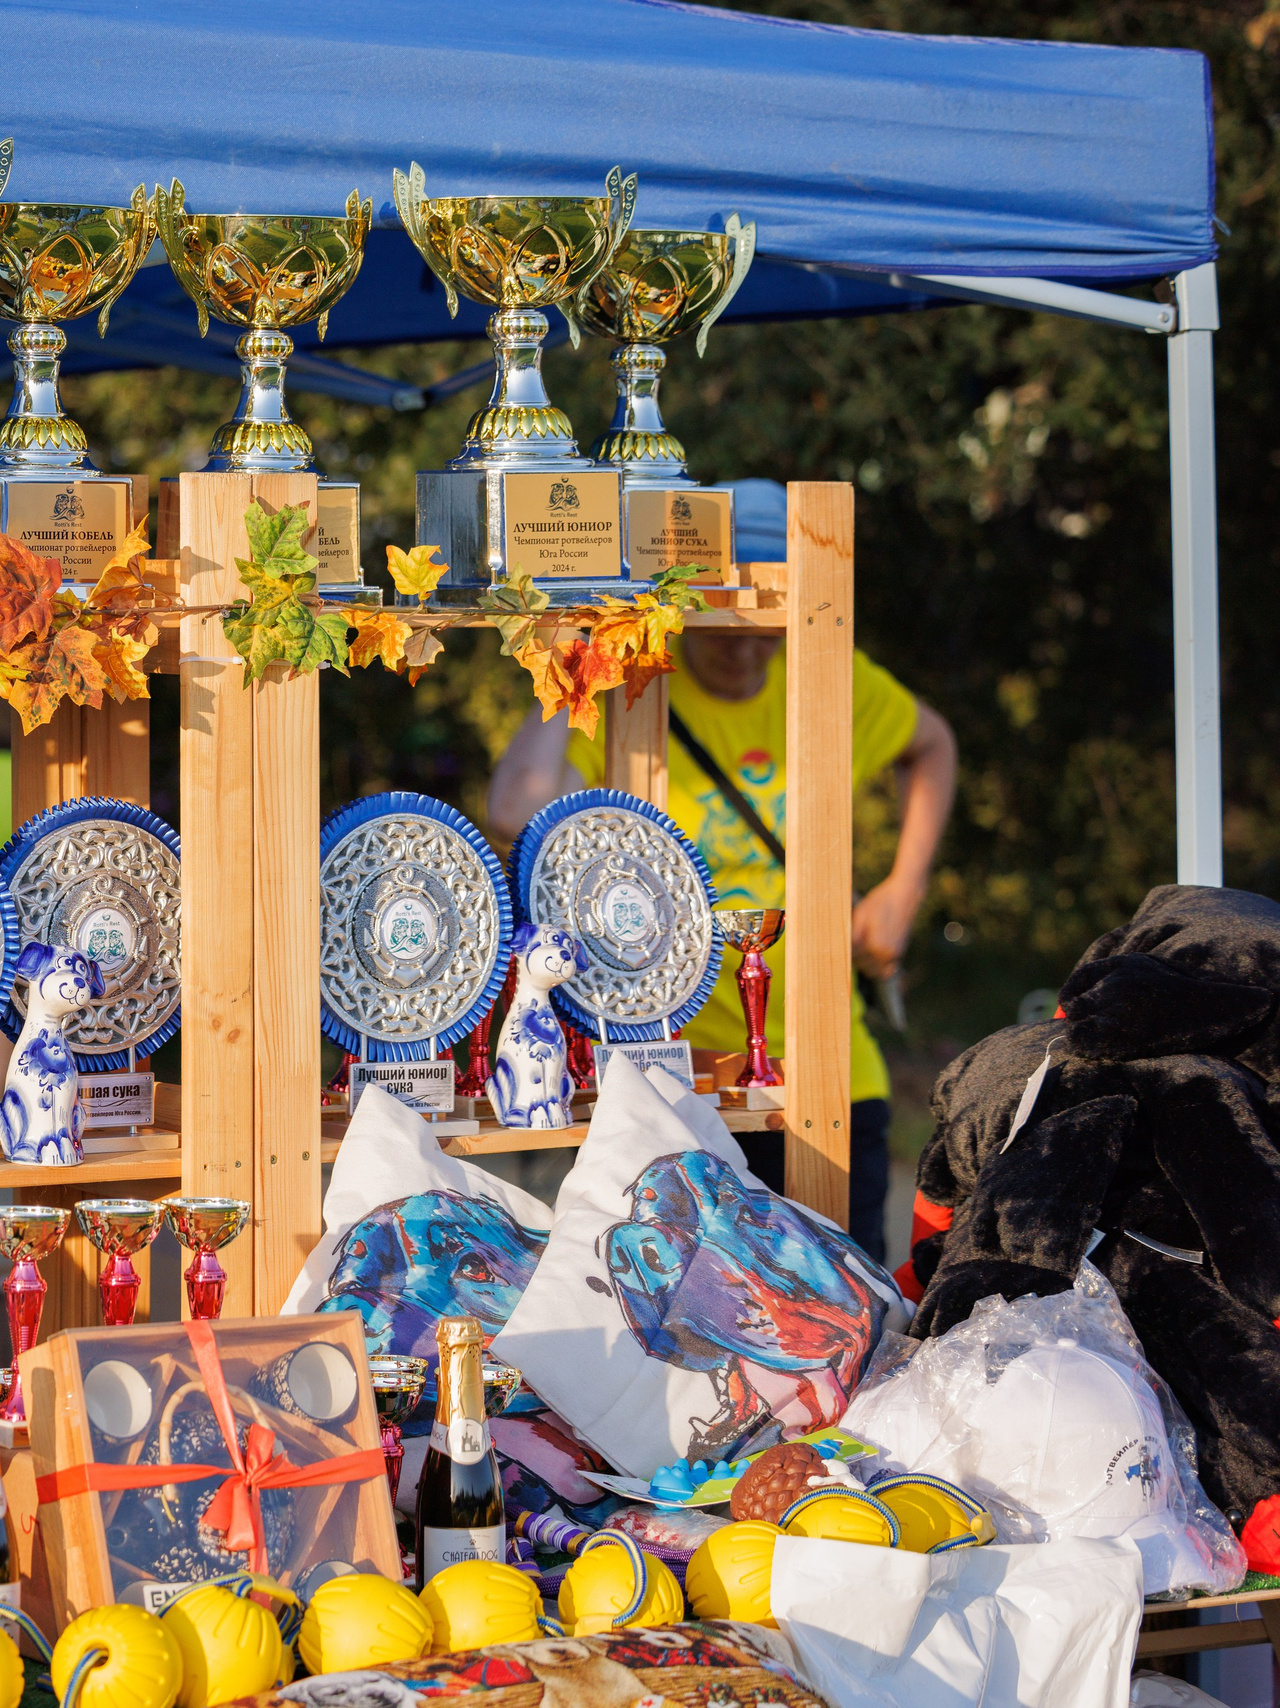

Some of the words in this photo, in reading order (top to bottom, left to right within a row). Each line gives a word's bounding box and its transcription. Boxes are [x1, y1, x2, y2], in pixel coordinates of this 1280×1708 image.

[513, 520, 565, 533] ЛУЧШИЙ
[567, 521, 612, 532] ЮНИОР
[20, 529, 68, 540] ЛУЧШИЙ
[71, 530, 114, 540] КОБЕЛЬ
[660, 528, 698, 537] ЛУЧШИЙ
[318, 537, 340, 546] БЕЛЬ
[514, 536, 559, 546] Чемпионат
[561, 535, 613, 547] ротвейлеров
[650, 537, 685, 546] ЮНИОР
[686, 538, 708, 547] СУКА
[65, 543, 117, 555] ротвейлеров
[539, 549, 557, 559] Юга
[559, 549, 588, 558] России
[636, 546, 677, 556] Чемпионат
[63, 555, 92, 565] России
[552, 564, 570, 572] 2024
[647, 1047, 684, 1060] юниор
[358, 1065, 405, 1083] Лучший
[408, 1067, 448, 1081] юниор
[77, 1086, 110, 1099] чшая
[112, 1084, 140, 1099] сука
[386, 1081, 414, 1095] сука
[481, 1548, 498, 1561] DOG
